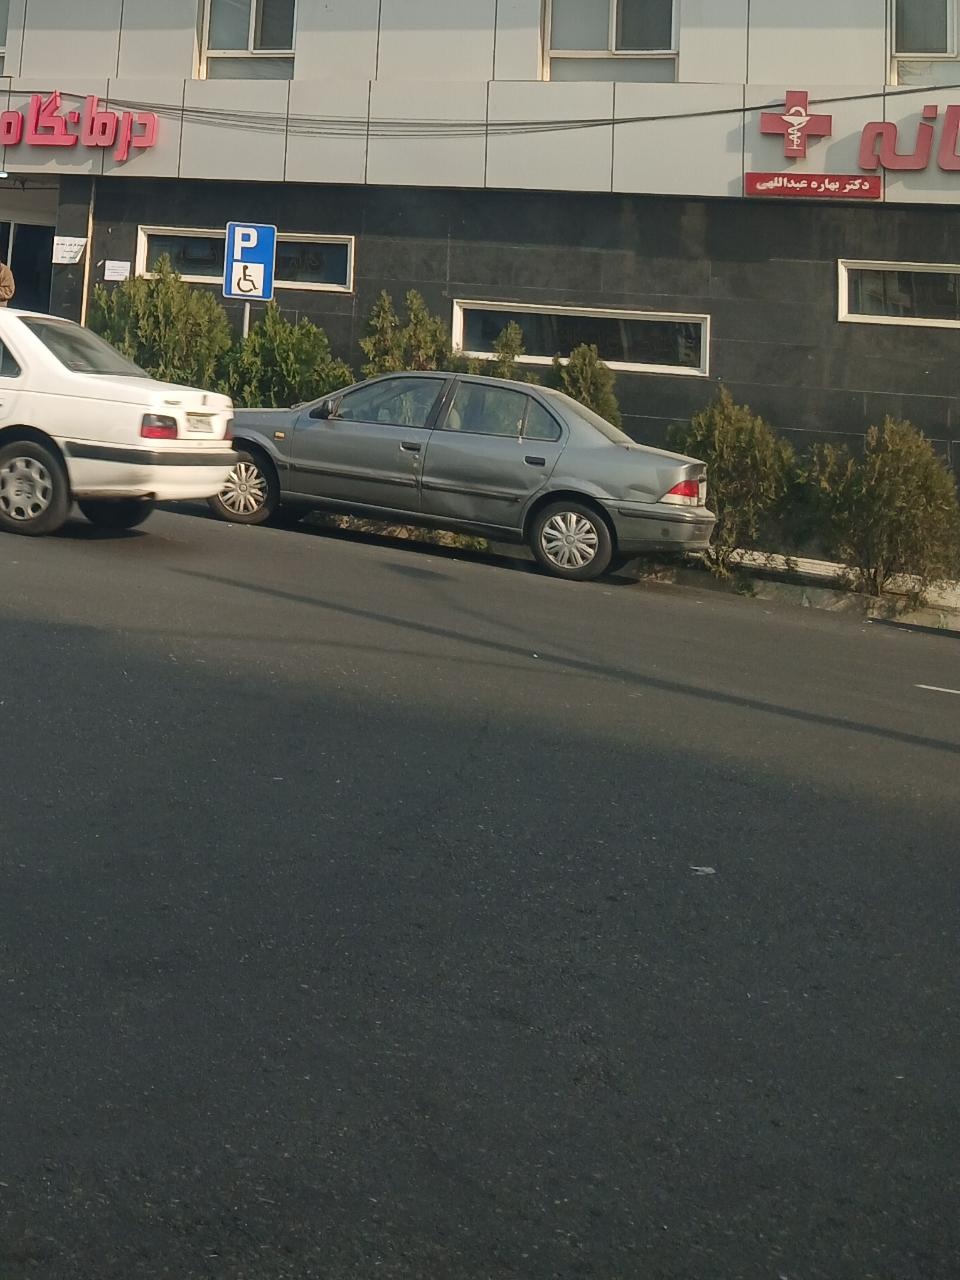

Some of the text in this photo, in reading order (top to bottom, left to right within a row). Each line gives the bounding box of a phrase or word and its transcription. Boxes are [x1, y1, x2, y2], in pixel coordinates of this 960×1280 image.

[756, 176, 870, 193] دکتر بهاره عبداللهی
[233, 226, 258, 260] P
